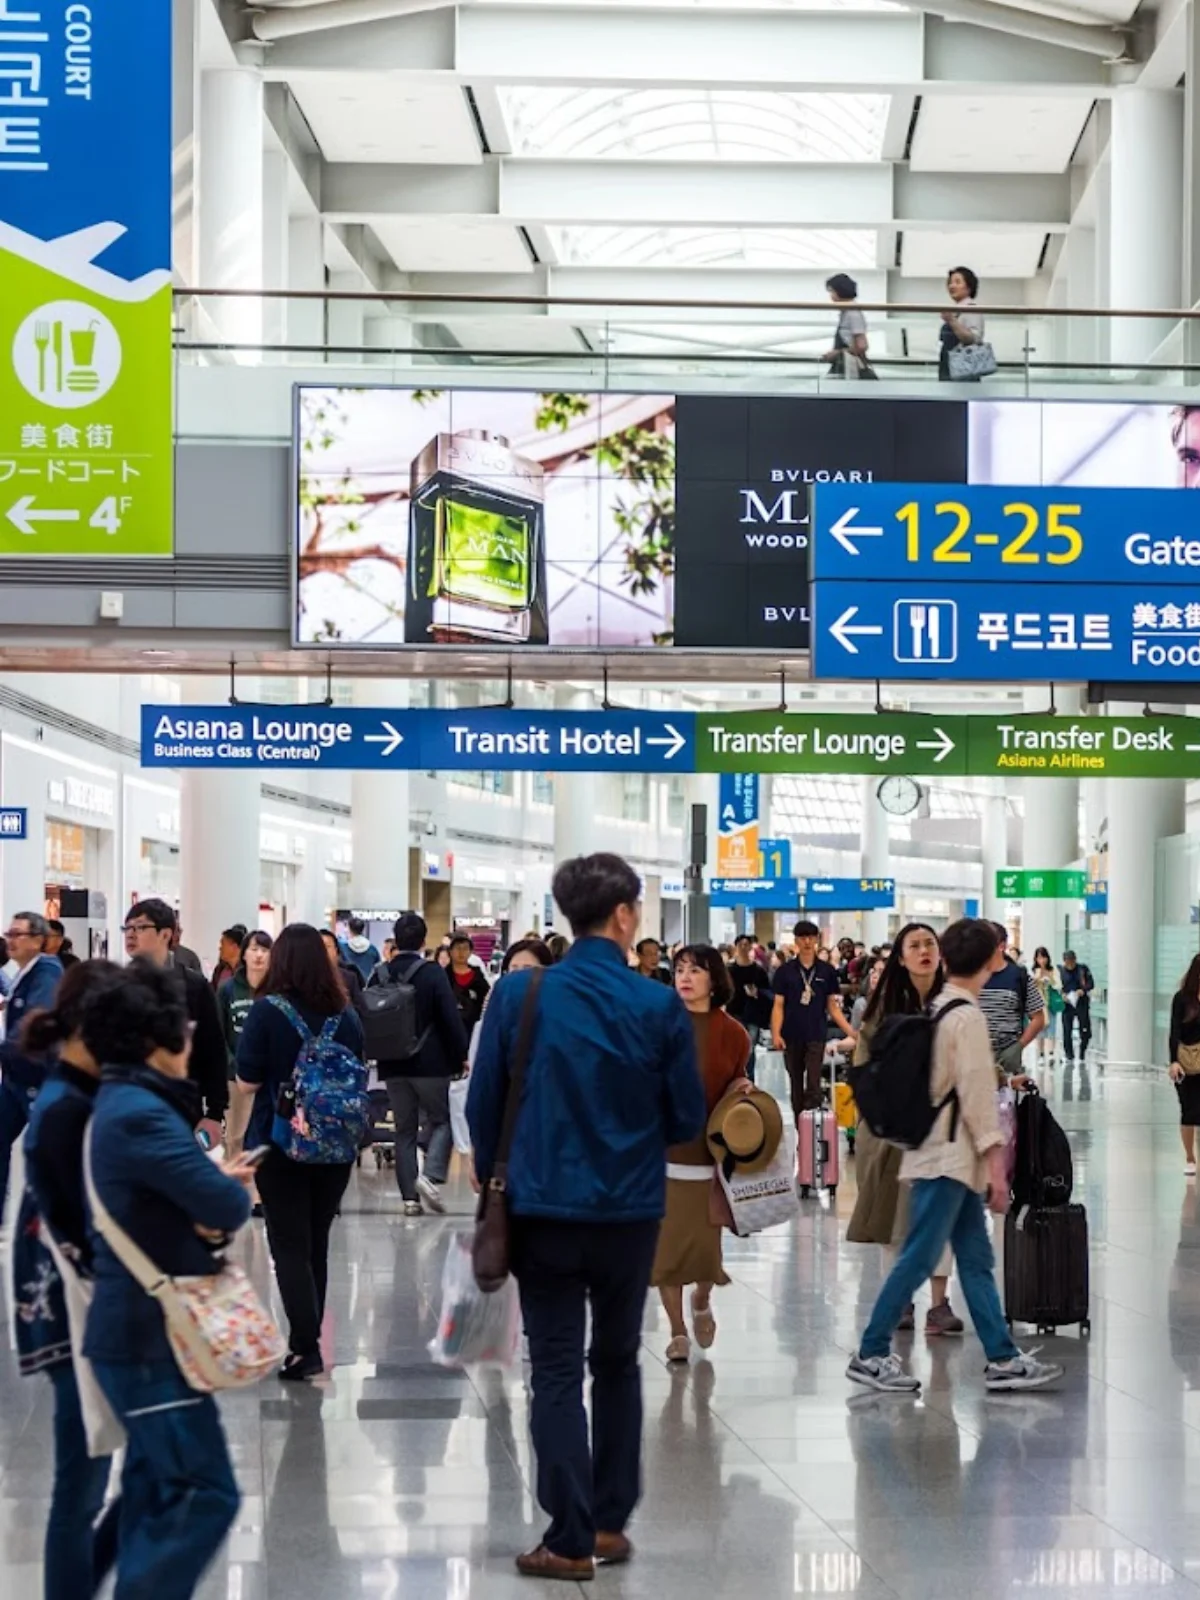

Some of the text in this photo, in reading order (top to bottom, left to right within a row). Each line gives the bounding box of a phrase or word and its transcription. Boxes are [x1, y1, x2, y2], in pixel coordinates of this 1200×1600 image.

[64, 4, 92, 100] COURT
[20, 422, 113, 448] 美食街
[0, 459, 141, 483] フードコート
[771, 469, 873, 484] BVLGARI
[745, 534, 808, 548] WOOD
[895, 501, 1083, 565] 12-25
[977, 612, 1112, 651] 푸드코트
[154, 715, 352, 747] Asiana Lounge
[448, 726, 641, 755] Transit Hotel
[708, 726, 906, 762] Transfer Lounge
[997, 725, 1174, 751] Transfer Desk
[154, 743, 321, 762] Business Class (Central)
[997, 754, 1105, 769] Asiana Airlines
